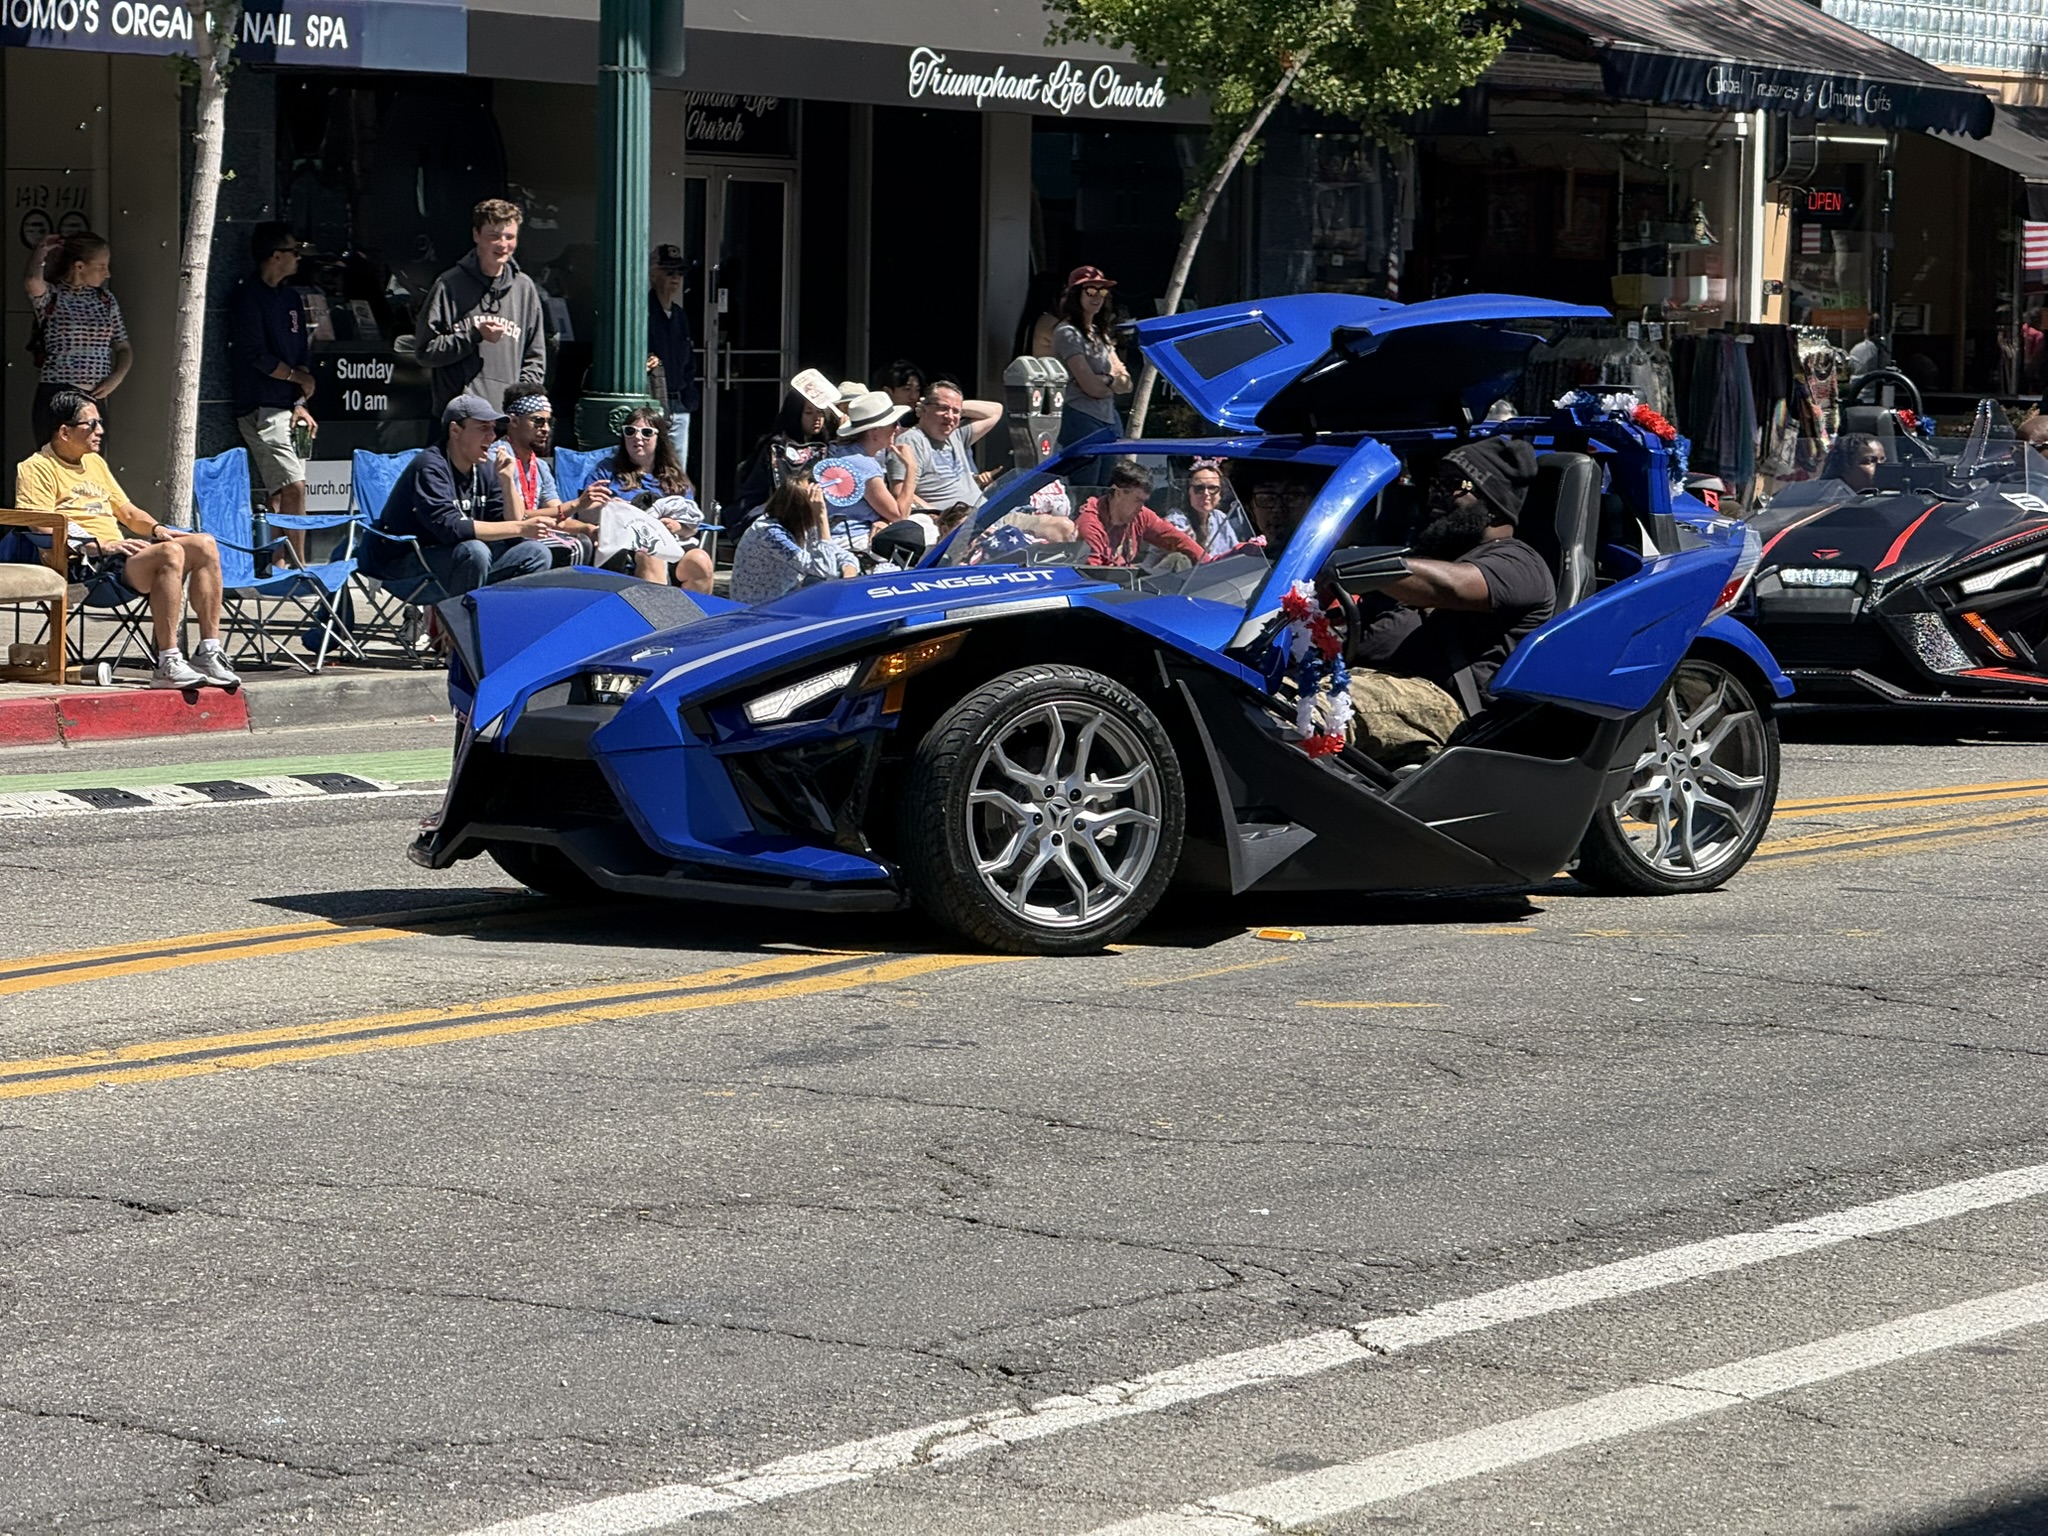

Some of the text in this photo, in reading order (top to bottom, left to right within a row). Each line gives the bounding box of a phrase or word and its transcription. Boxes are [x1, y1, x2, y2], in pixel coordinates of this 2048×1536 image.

[242, 11, 296, 45] NAIL
[305, 14, 348, 49] SPA
[909, 46, 1167, 115] Triumphant Life Church
[1706, 66, 1892, 116] Global Treasures & Unique Gifts
[686, 110, 744, 142] Church
[1808, 192, 1842, 210] OPEN
[337, 358, 394, 384] Sunday
[342, 390, 388, 411] 10 am
[866, 569, 1056, 599] SLINGSHOT
[1084, 681, 1140, 717] KENDA
